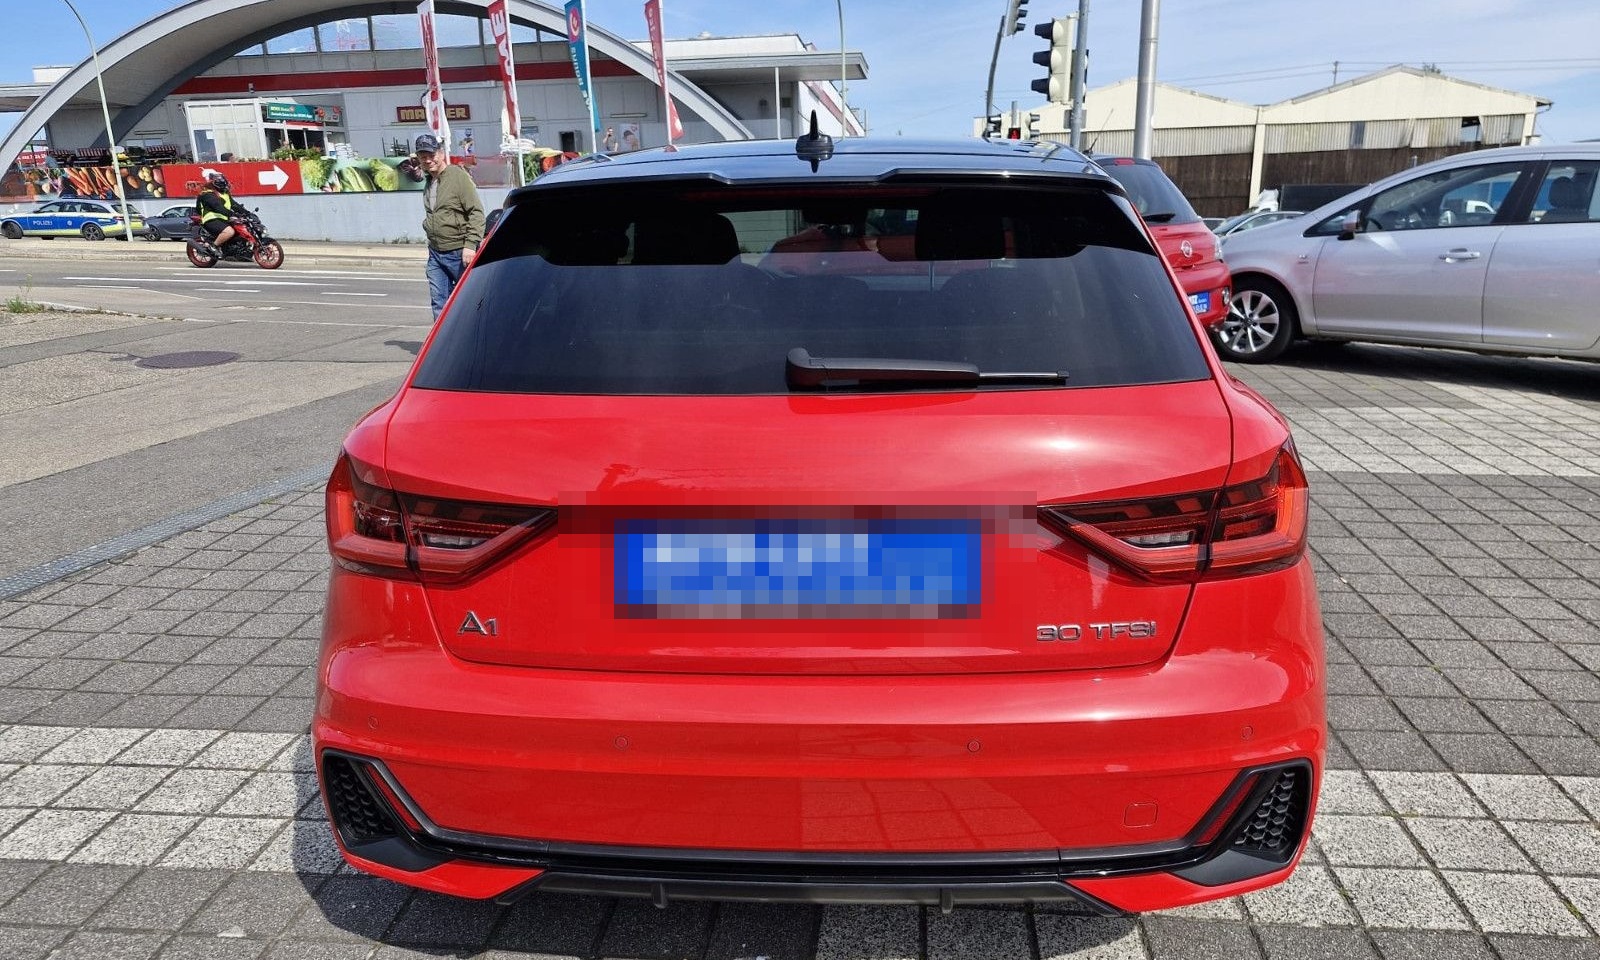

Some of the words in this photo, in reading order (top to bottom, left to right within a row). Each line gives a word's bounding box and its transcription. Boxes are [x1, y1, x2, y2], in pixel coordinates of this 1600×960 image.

[400, 107, 468, 120] MAER
[457, 610, 498, 636] A1
[1036, 624, 1081, 641] 30
[1089, 621, 1156, 640] TFSI
